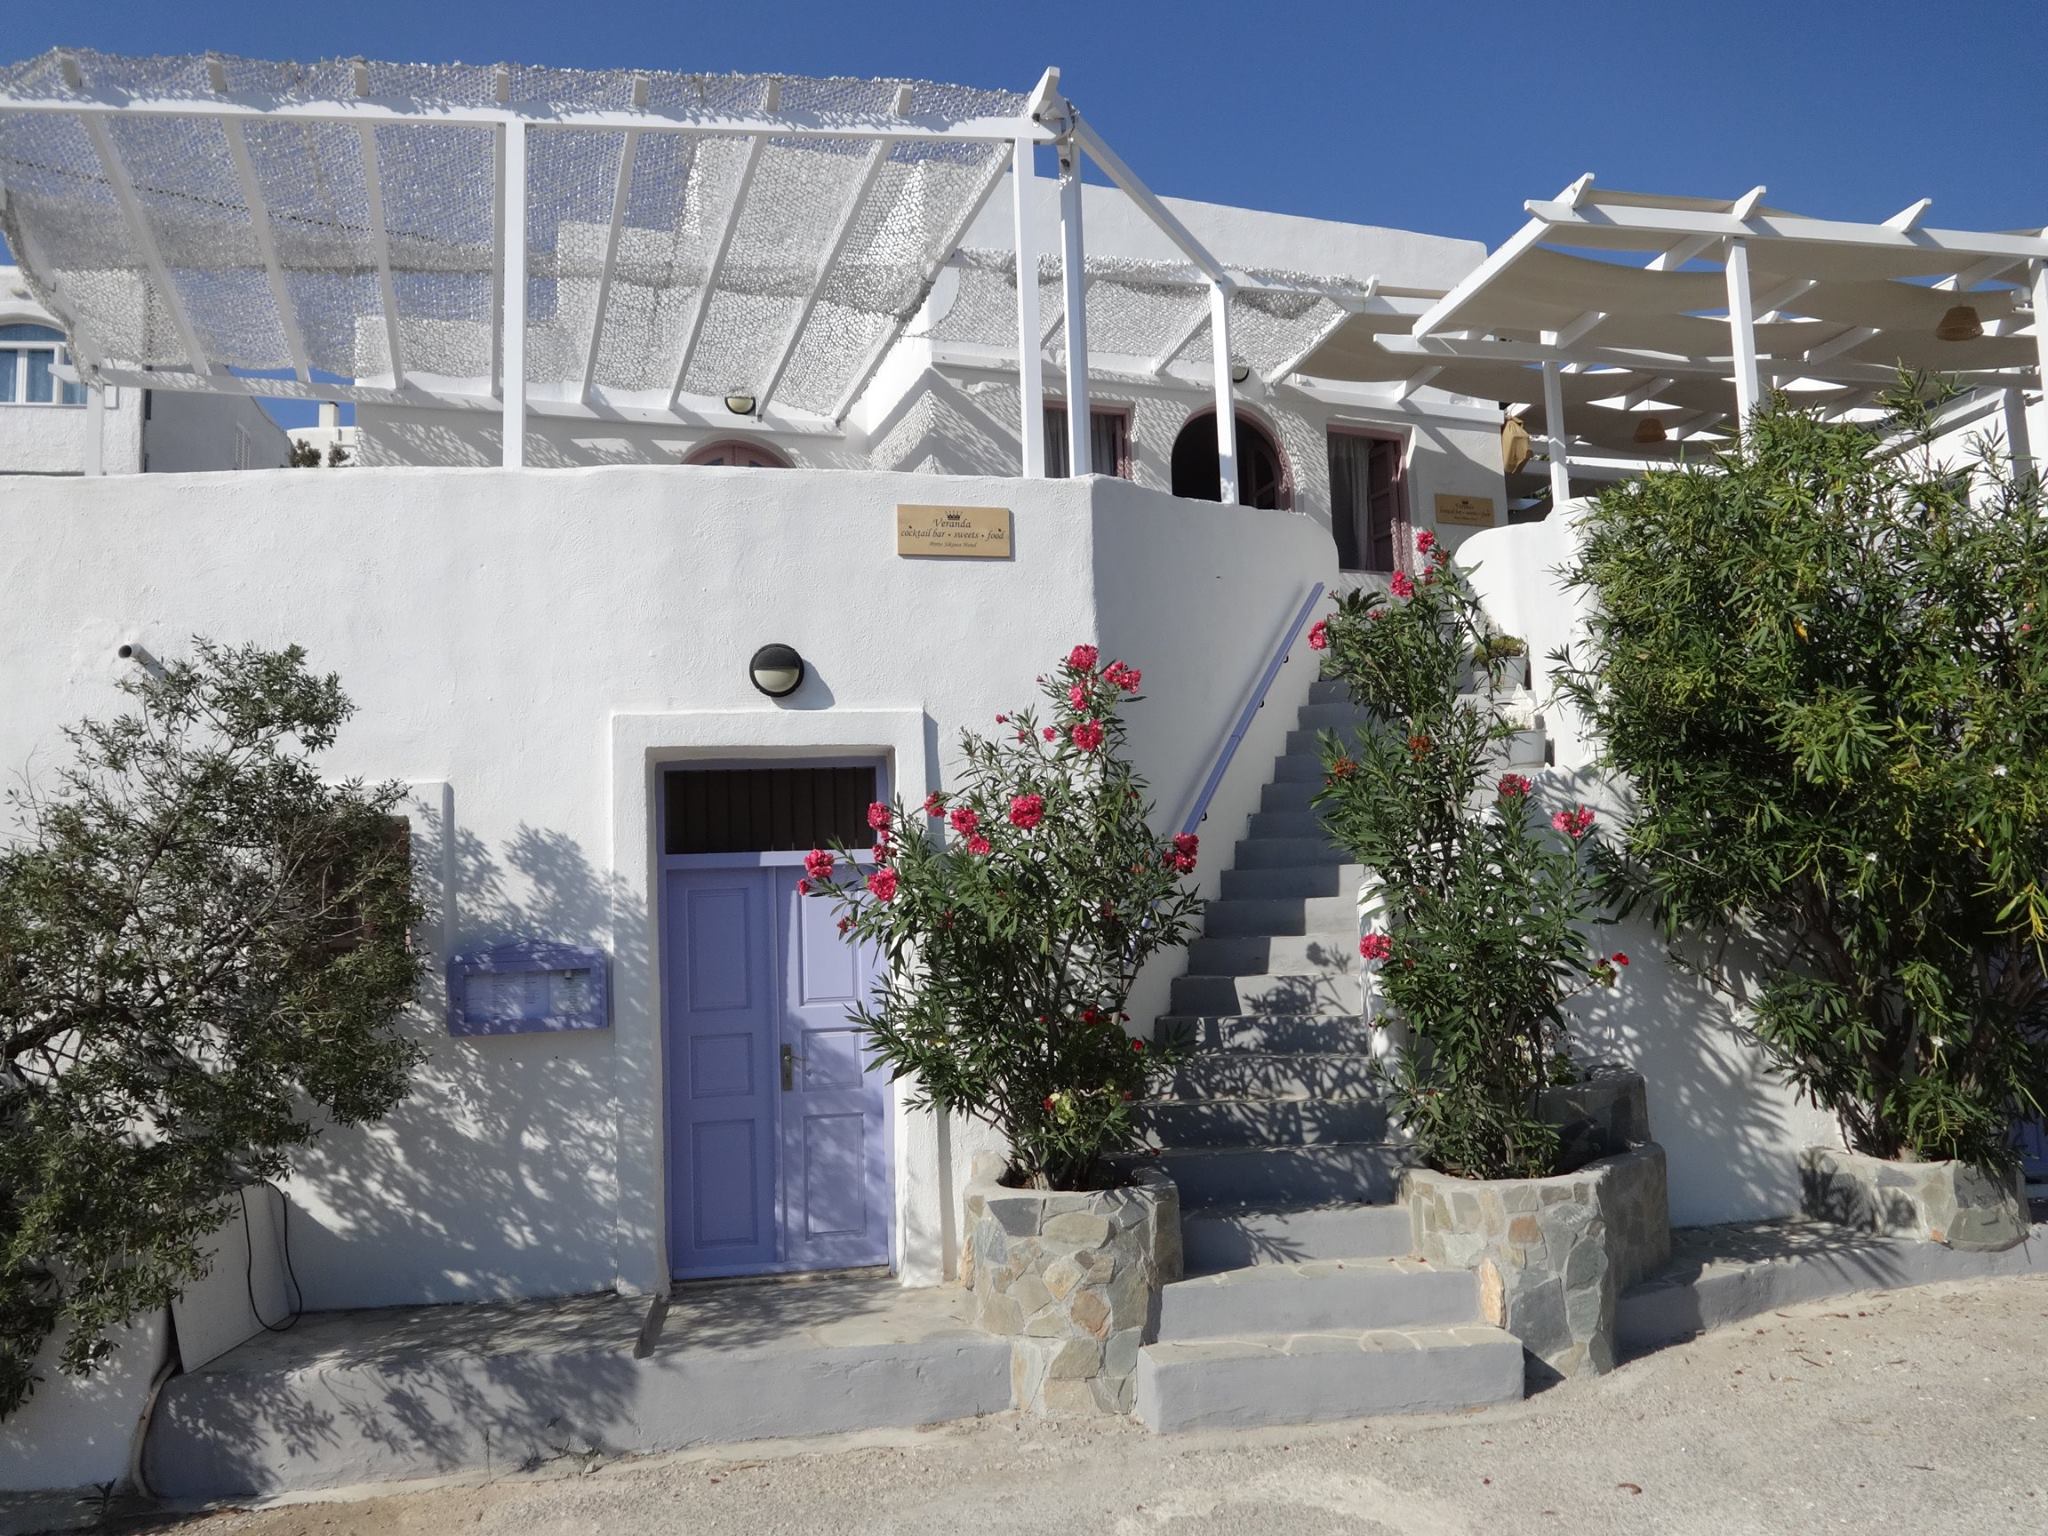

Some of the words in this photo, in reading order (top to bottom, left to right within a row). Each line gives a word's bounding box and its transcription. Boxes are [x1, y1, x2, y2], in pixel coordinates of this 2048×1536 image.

[933, 518, 971, 528] Veranda
[901, 528, 932, 539] cocktail
[932, 528, 945, 537] bar
[953, 531, 979, 539] sweets
[985, 530, 1006, 541] food
